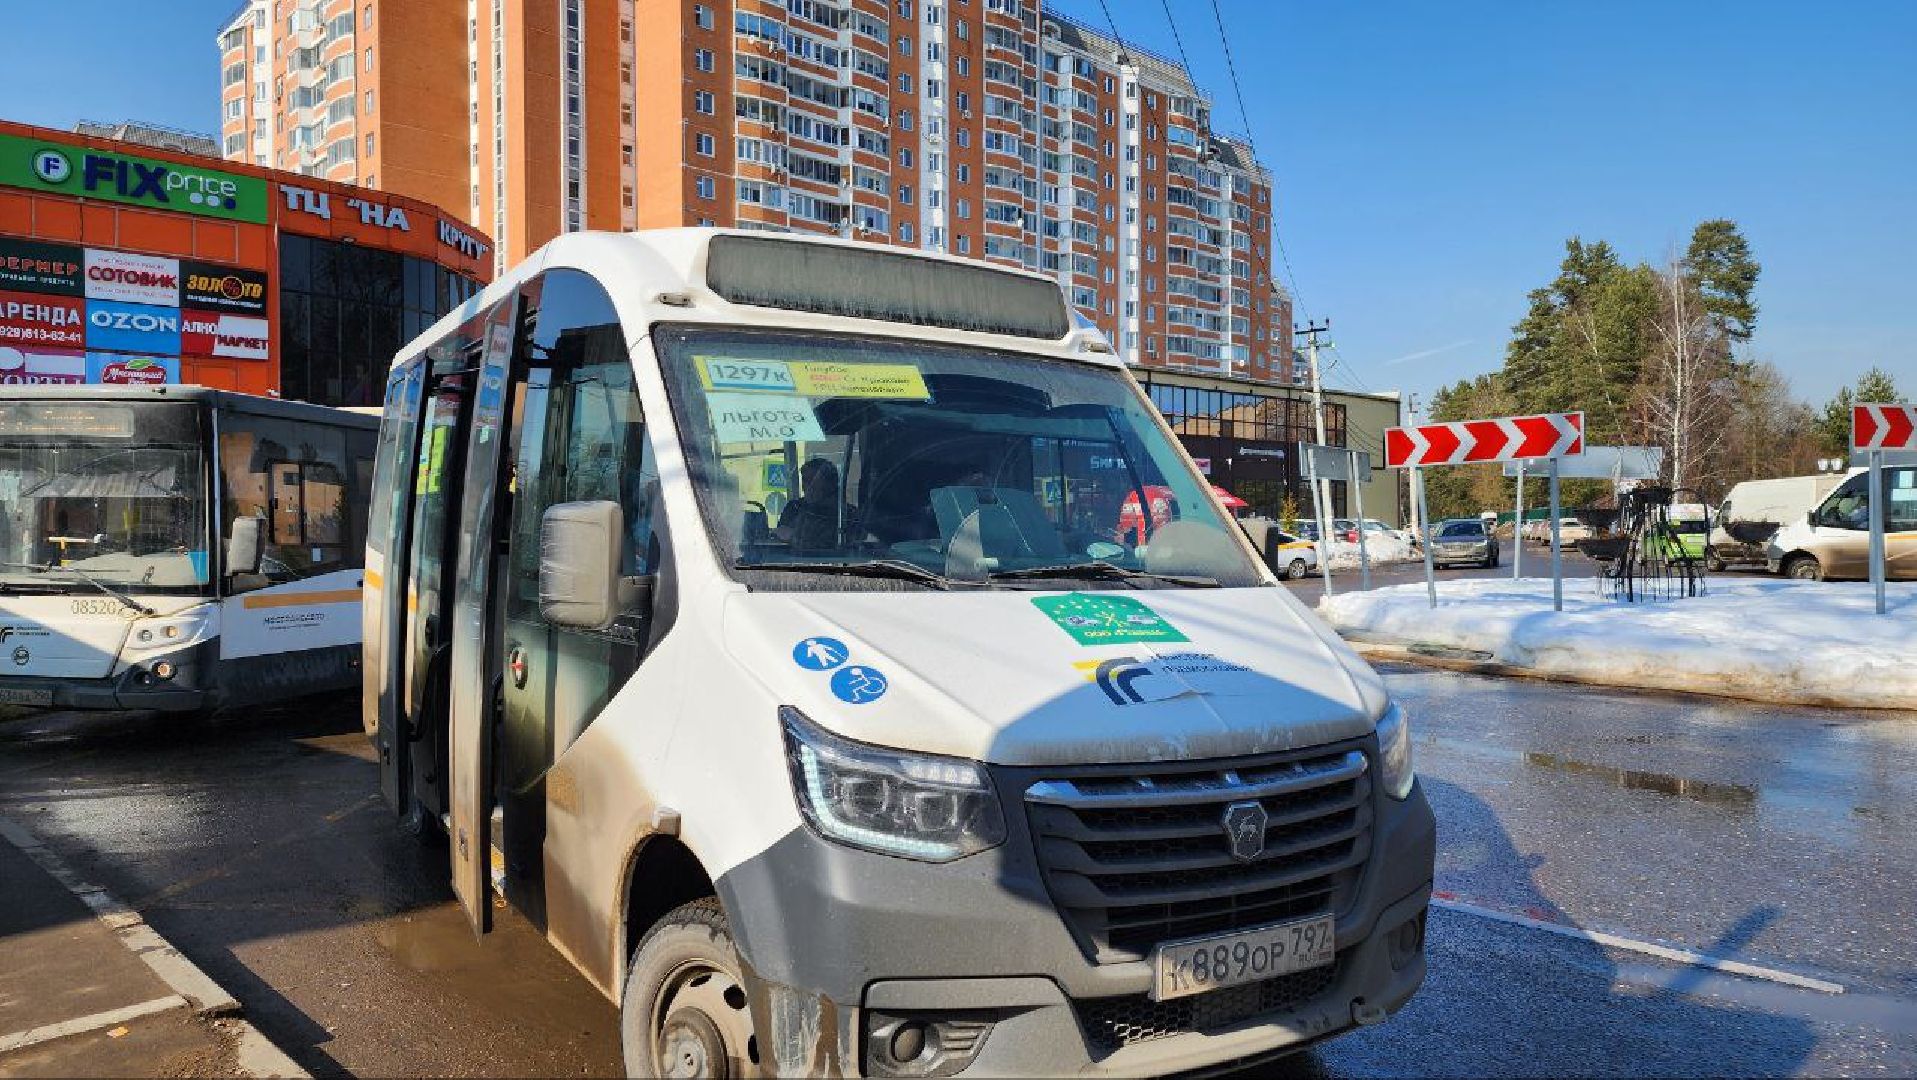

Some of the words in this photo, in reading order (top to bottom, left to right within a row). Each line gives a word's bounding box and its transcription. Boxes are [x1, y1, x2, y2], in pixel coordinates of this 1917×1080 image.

[83, 154, 169, 203] FIX
[166, 172, 237, 197] price
[279, 184, 331, 219] ТЦ
[89, 265, 178, 290] СОТОВИК
[91, 310, 177, 333] OZON
[217, 334, 267, 351] МАРКЕТ
[1291, 921, 1330, 956] 797
